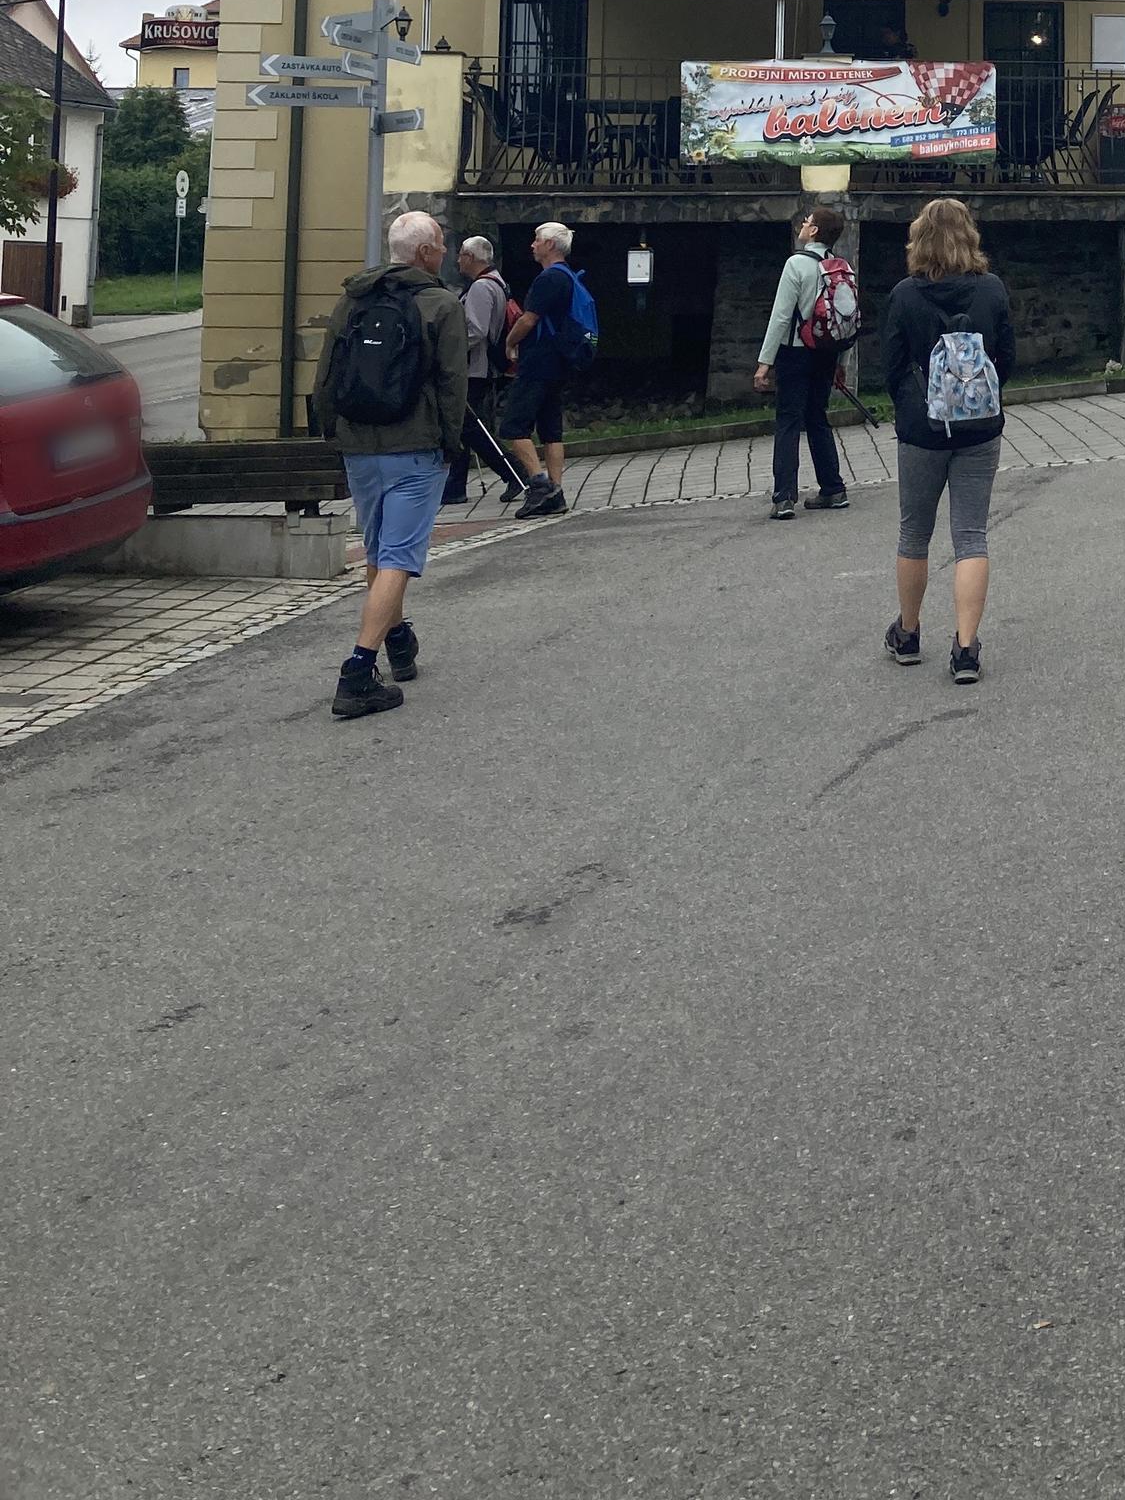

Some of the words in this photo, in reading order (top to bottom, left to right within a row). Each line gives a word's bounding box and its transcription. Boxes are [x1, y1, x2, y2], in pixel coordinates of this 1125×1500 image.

[281, 61, 321, 72] ZASTÁVKA
[719, 66, 785, 80] PRODEJNÍ
[788, 66, 826, 80] MÍSTO
[829, 69, 874, 80] LETENEK
[269, 89, 310, 100] ZÁKLADNÍ
[311, 90, 339, 101] ŠKOLA
[764, 99, 946, 142] balónem
